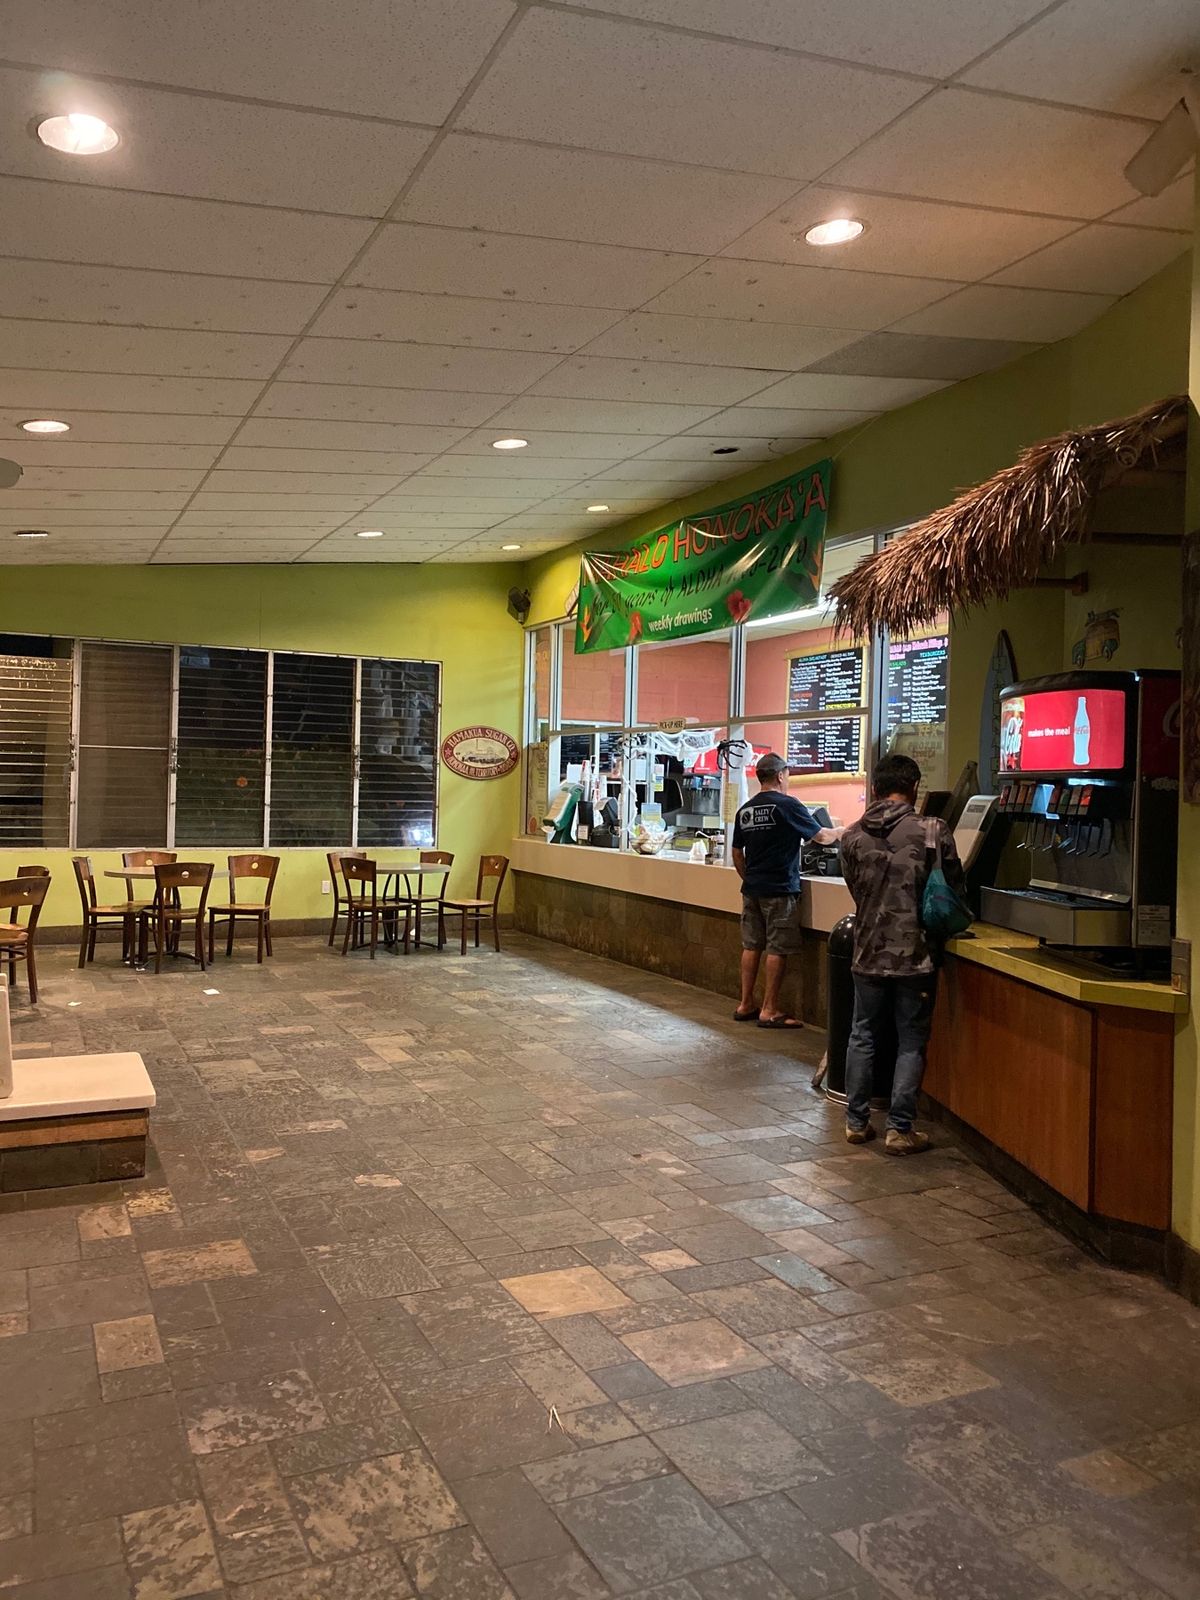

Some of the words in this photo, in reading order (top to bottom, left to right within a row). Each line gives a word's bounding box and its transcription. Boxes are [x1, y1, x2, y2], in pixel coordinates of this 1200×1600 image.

[677, 562, 725, 598] ALOHA
[647, 614, 674, 631] weekly
[674, 607, 712, 627] drawings
[485, 729, 508, 744] SUGAR
[1028, 729, 1044, 737] makes
[1044, 727, 1054, 736] the
[1055, 726, 1070, 735] meal
[755, 807, 771, 815] SALTY
[754, 815, 770, 823] CREW
